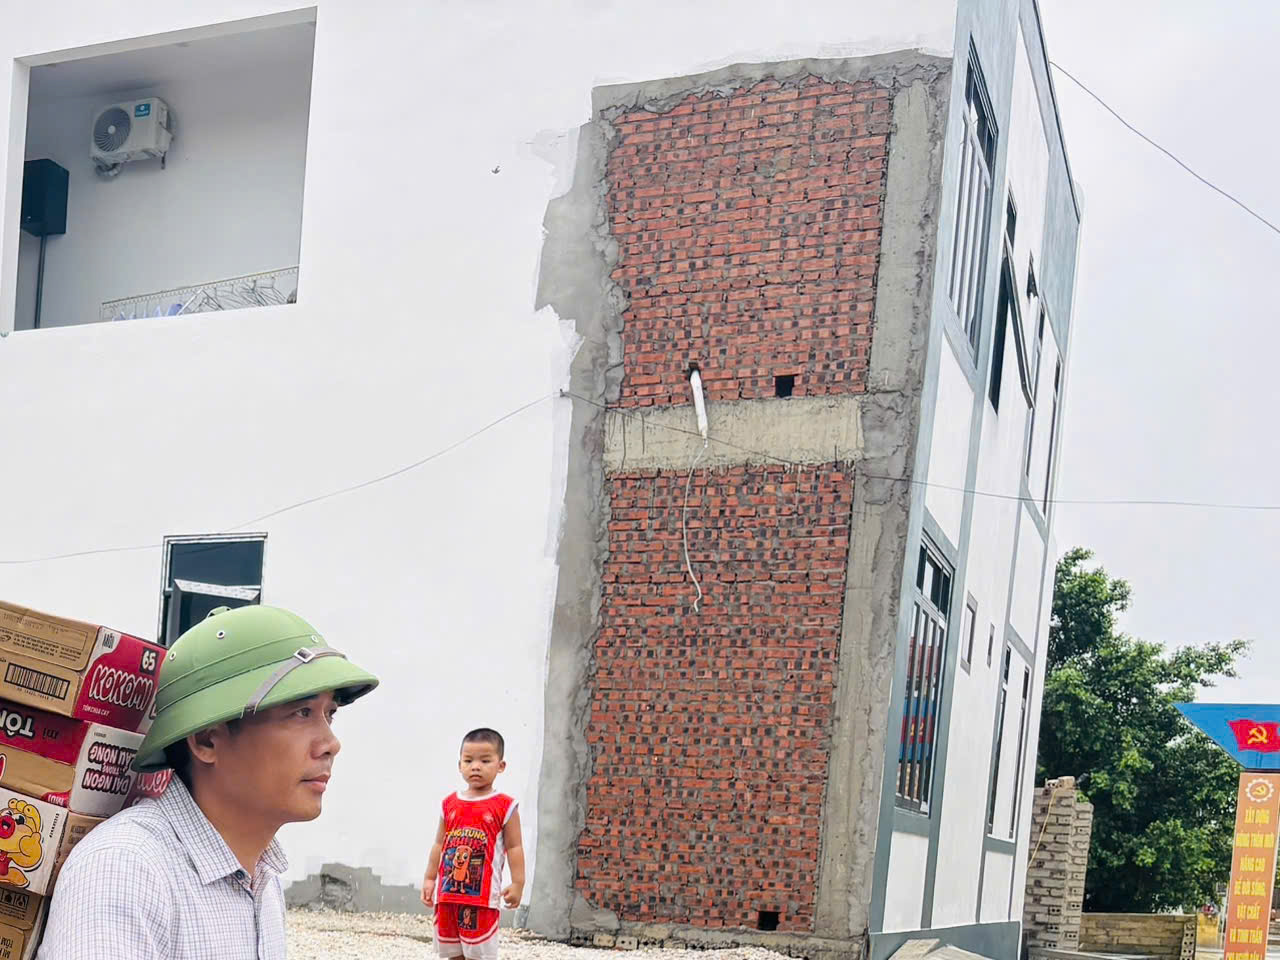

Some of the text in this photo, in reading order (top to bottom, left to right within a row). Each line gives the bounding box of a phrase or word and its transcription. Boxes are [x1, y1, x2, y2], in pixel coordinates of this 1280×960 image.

[141, 650, 156, 671] 65
[89, 664, 154, 711] KOKOMI
[84, 771, 112, 791] NGON
